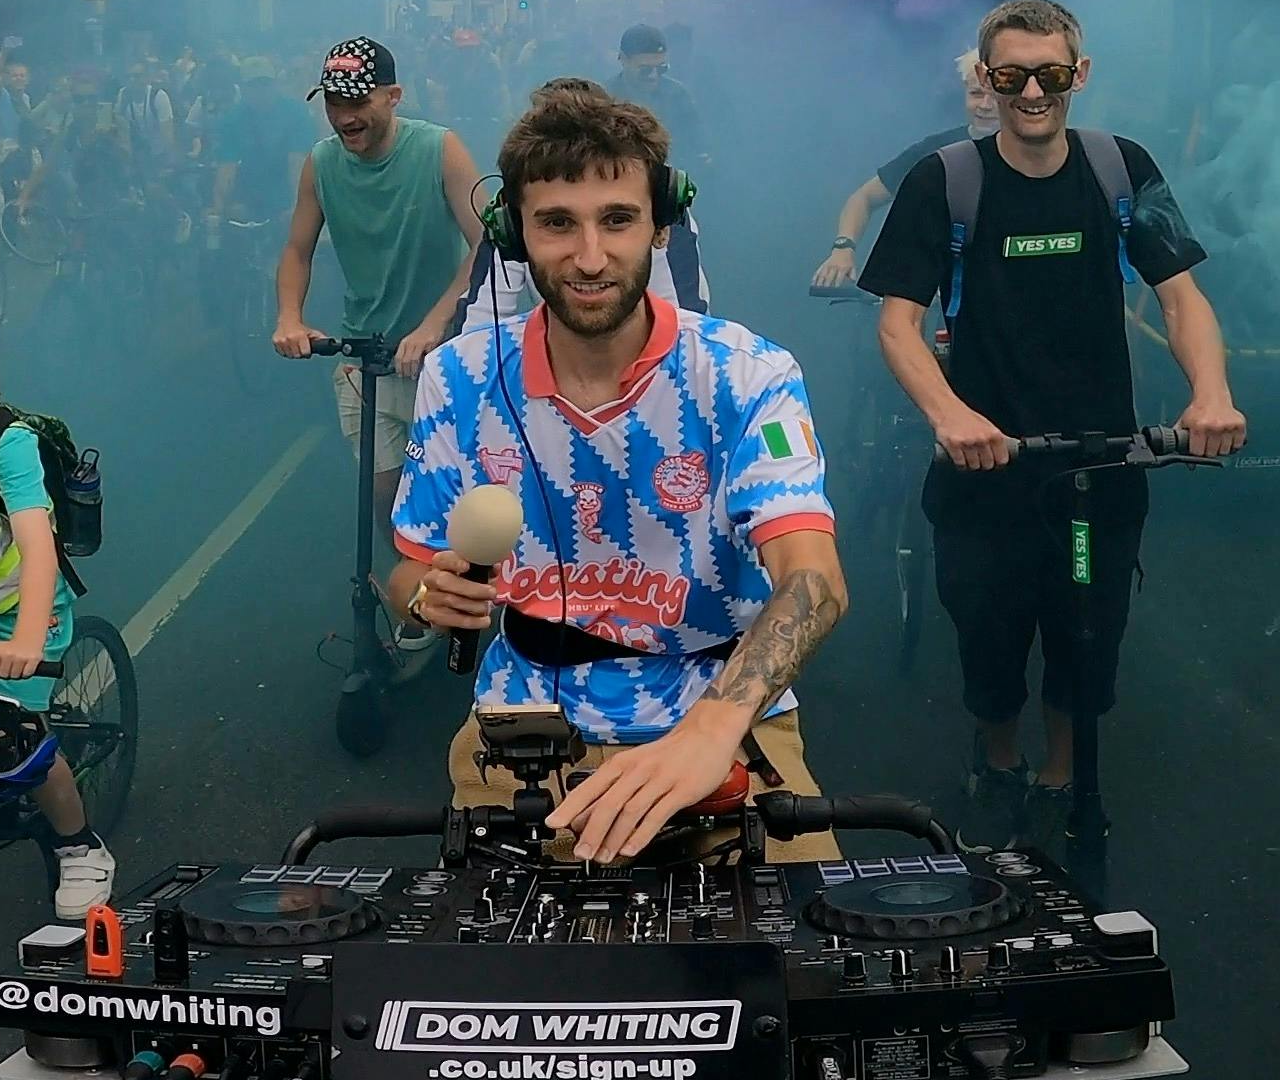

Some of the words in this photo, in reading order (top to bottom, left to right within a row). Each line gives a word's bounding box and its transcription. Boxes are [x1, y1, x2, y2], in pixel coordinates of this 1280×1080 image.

[1016, 239, 1046, 252] YES
[1048, 237, 1076, 250] YES
[1075, 530, 1086, 554] YES
[1076, 556, 1087, 578] YES
[415, 1012, 521, 1041] DOM
[532, 1012, 722, 1041] WHITING
[428, 1053, 697, 1080] .co.uk/sign-up
